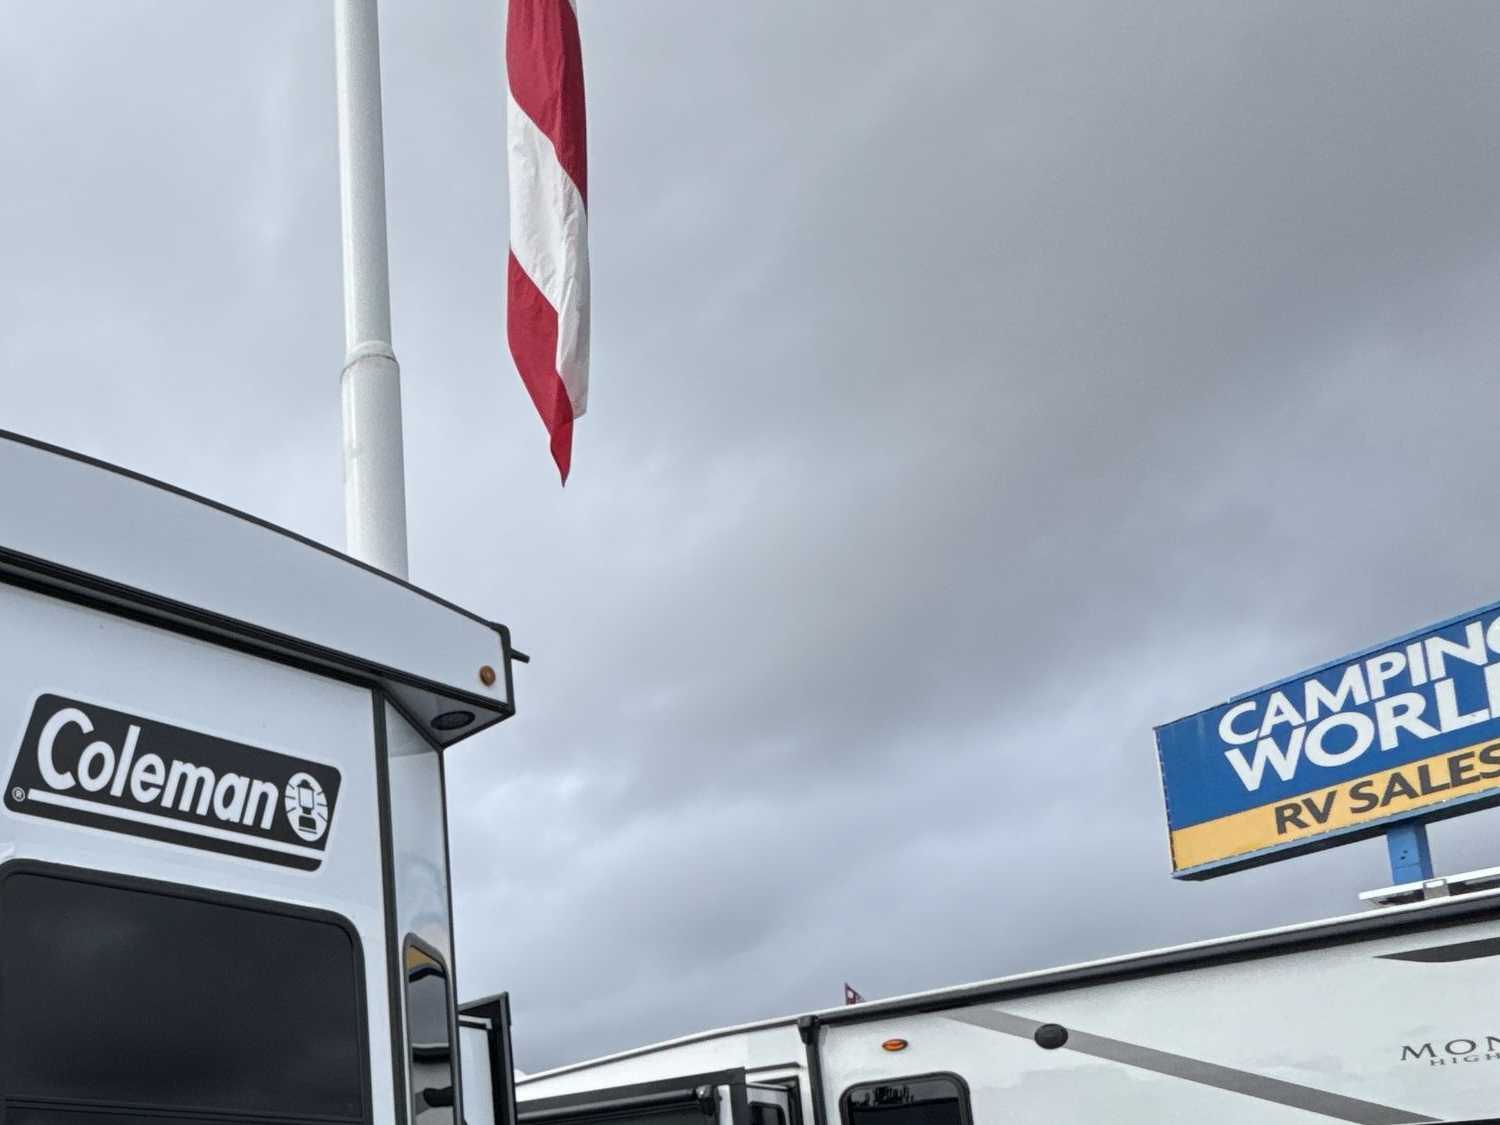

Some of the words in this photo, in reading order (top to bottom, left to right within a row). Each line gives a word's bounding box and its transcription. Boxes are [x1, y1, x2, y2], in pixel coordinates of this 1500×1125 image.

[1217, 614, 1500, 745] CAMPIN
[1224, 662, 1500, 791] WORL
[37, 707, 279, 830] Coleman
[1274, 790, 1337, 835] RV
